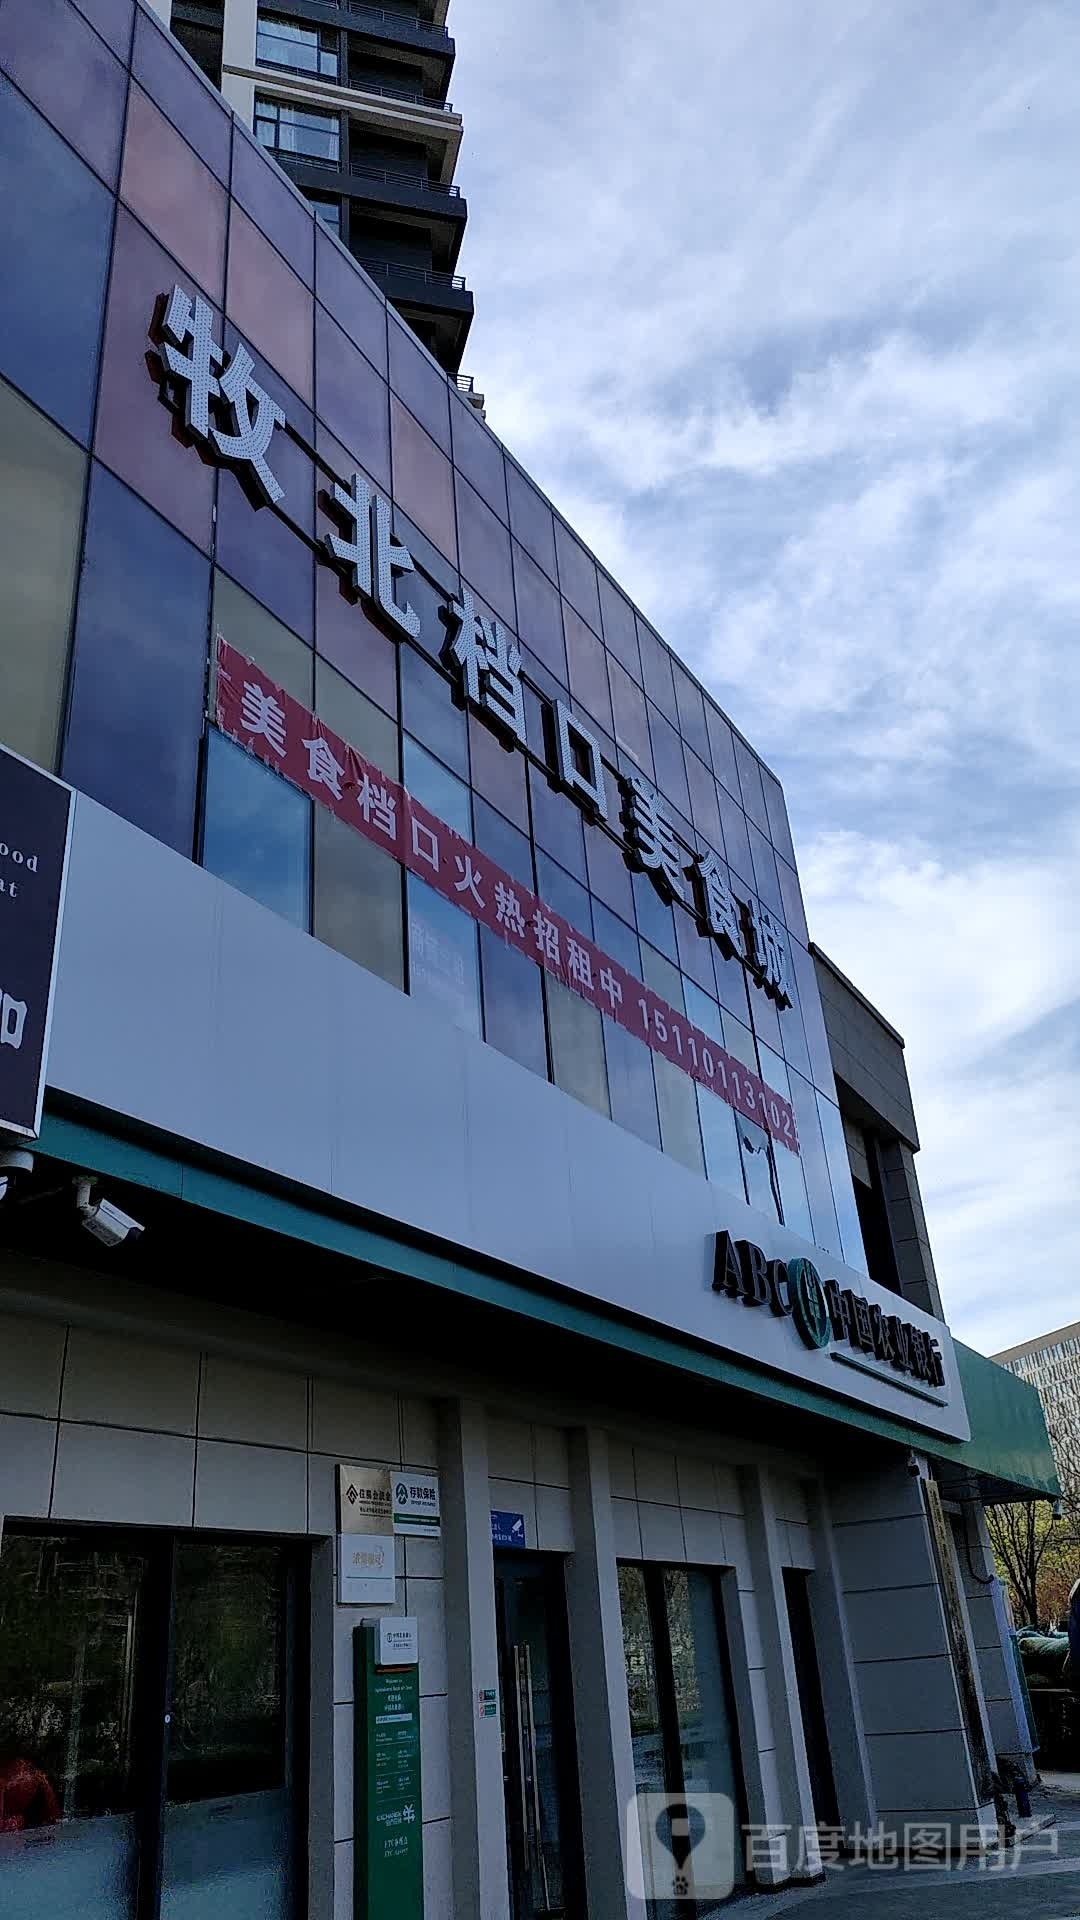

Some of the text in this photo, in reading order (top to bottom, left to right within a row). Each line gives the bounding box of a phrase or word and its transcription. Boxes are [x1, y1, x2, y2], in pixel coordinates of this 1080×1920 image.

[150, 284, 796, 1012] 牧北档口美食城
[240, 681, 793, 1139] 美食档口火热招租中 15110113102
[712, 1230, 793, 1318] ABC
[410, 1487, 436, 1501] 存款保险
